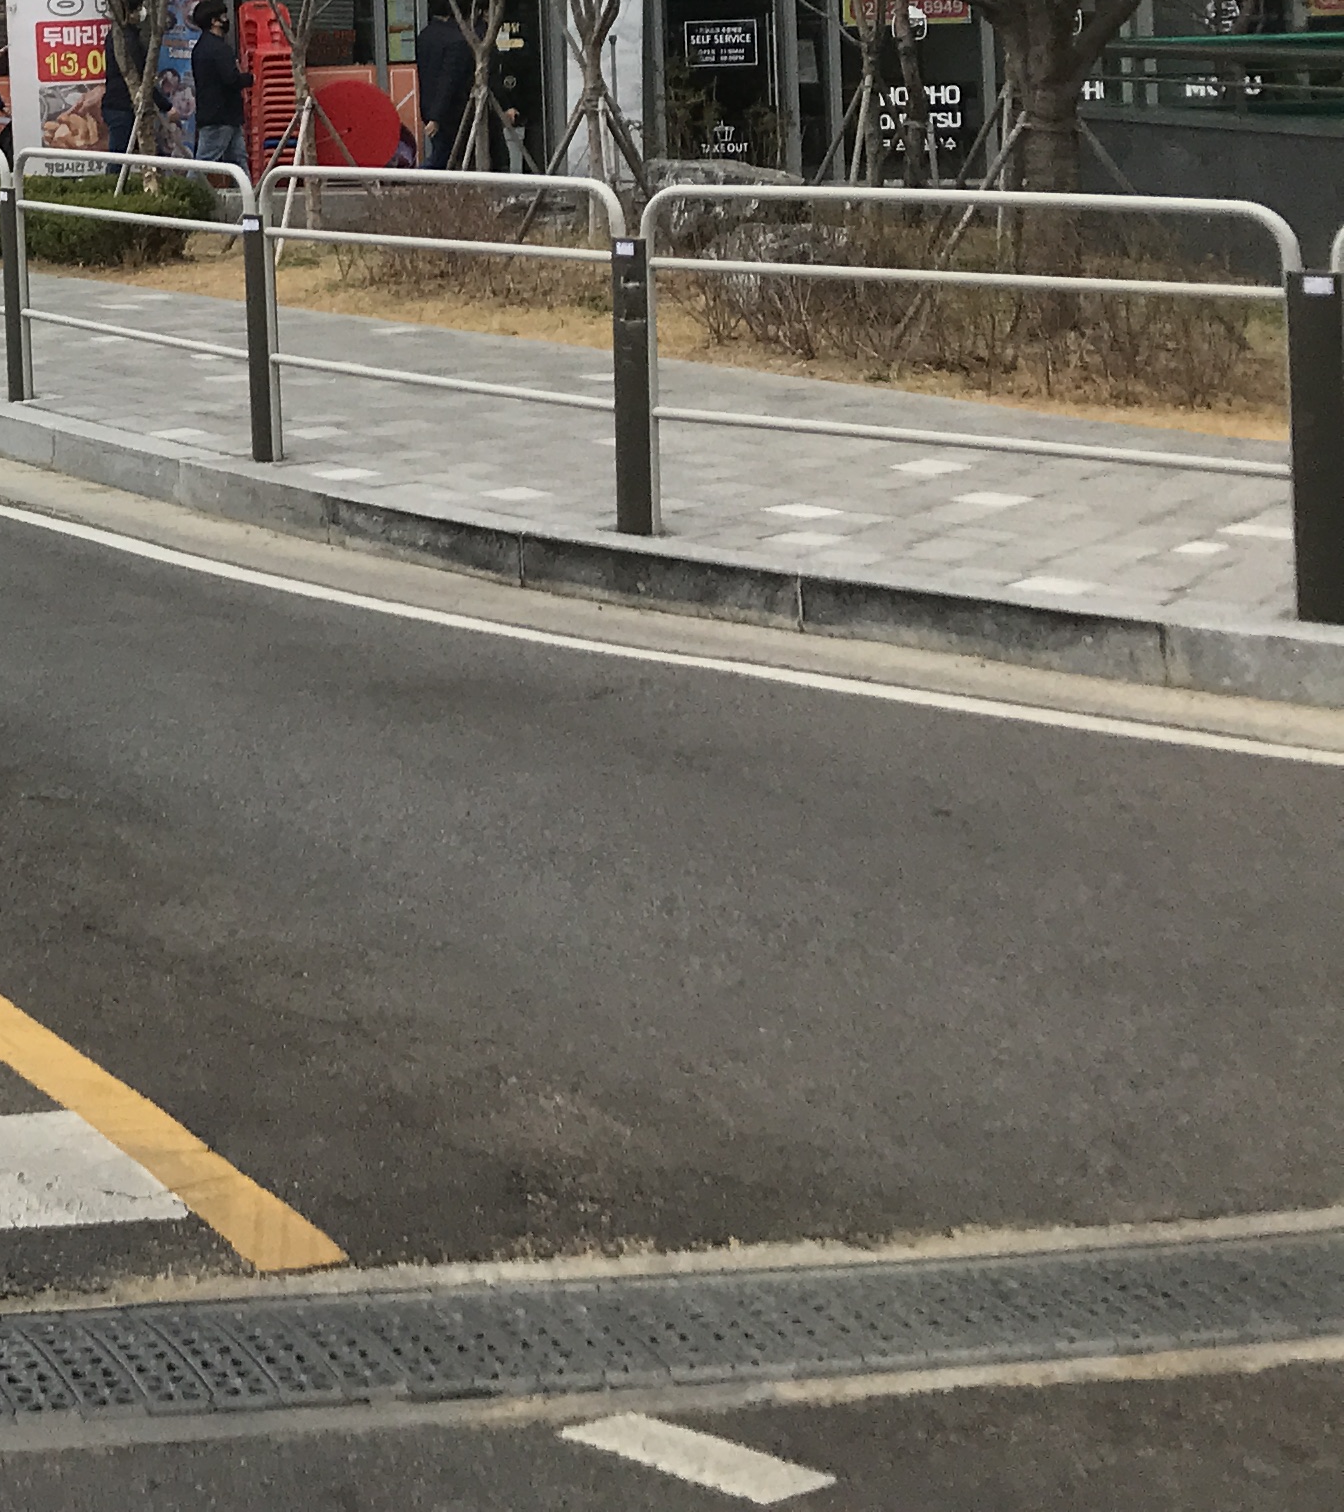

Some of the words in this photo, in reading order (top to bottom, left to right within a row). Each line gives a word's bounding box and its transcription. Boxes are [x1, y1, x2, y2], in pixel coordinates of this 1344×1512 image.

[43, 25, 98, 47] 두마리
[690, 35, 712, 45] SELF
[714, 33, 752, 44] SERVICE
